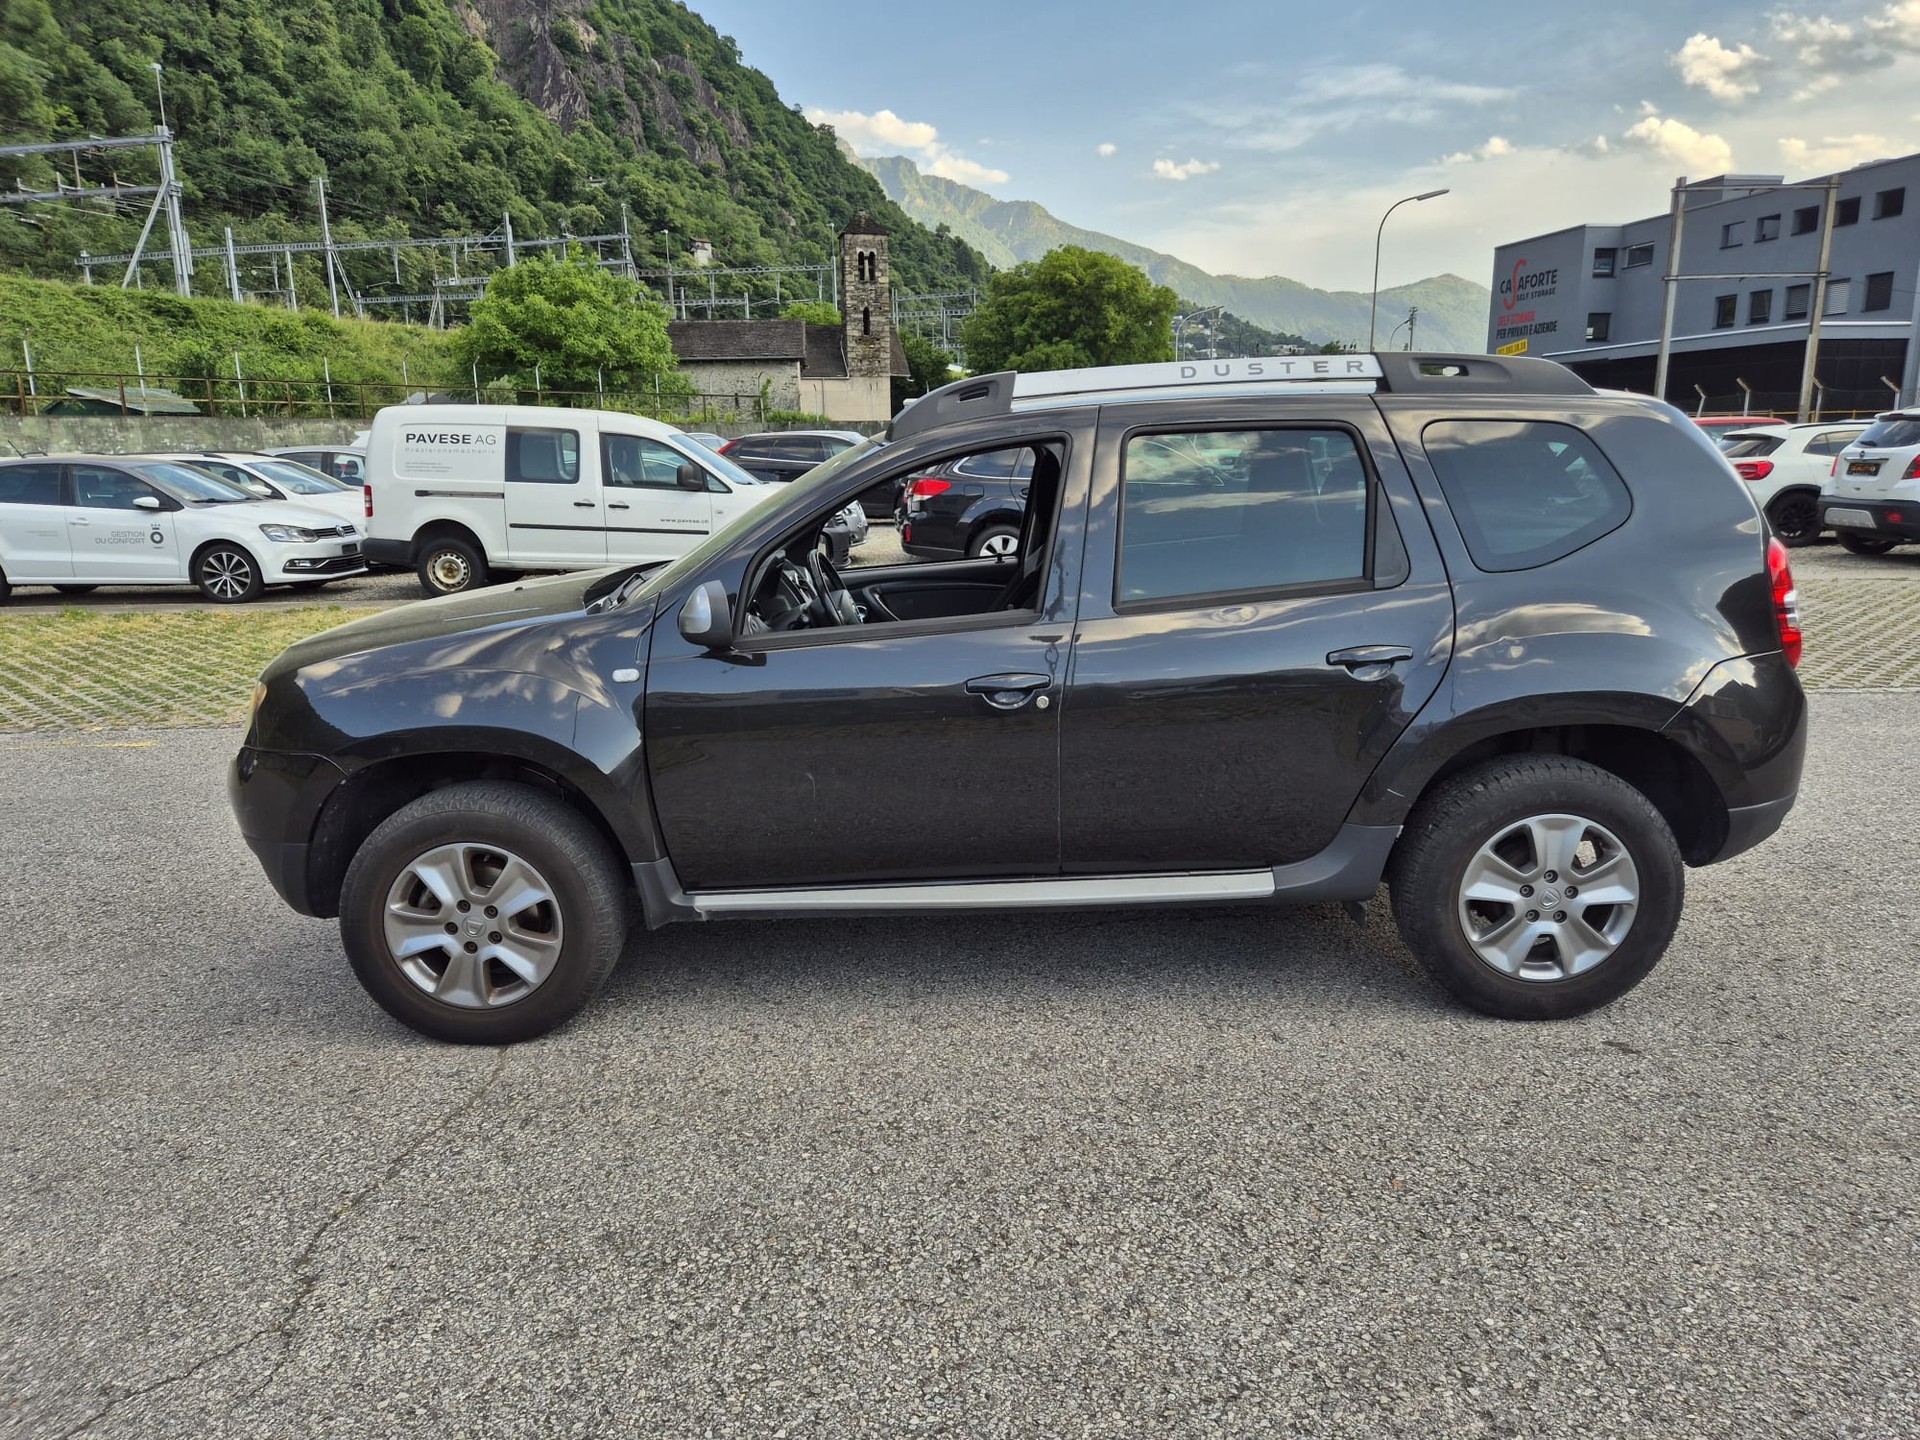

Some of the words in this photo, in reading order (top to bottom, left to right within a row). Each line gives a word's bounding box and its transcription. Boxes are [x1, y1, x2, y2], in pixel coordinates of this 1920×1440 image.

[1180, 360, 1365, 379] DUSTER
[405, 433, 472, 445] PAVESE
[474, 434, 497, 445] AG
[108, 537, 145, 545] CONFORT
